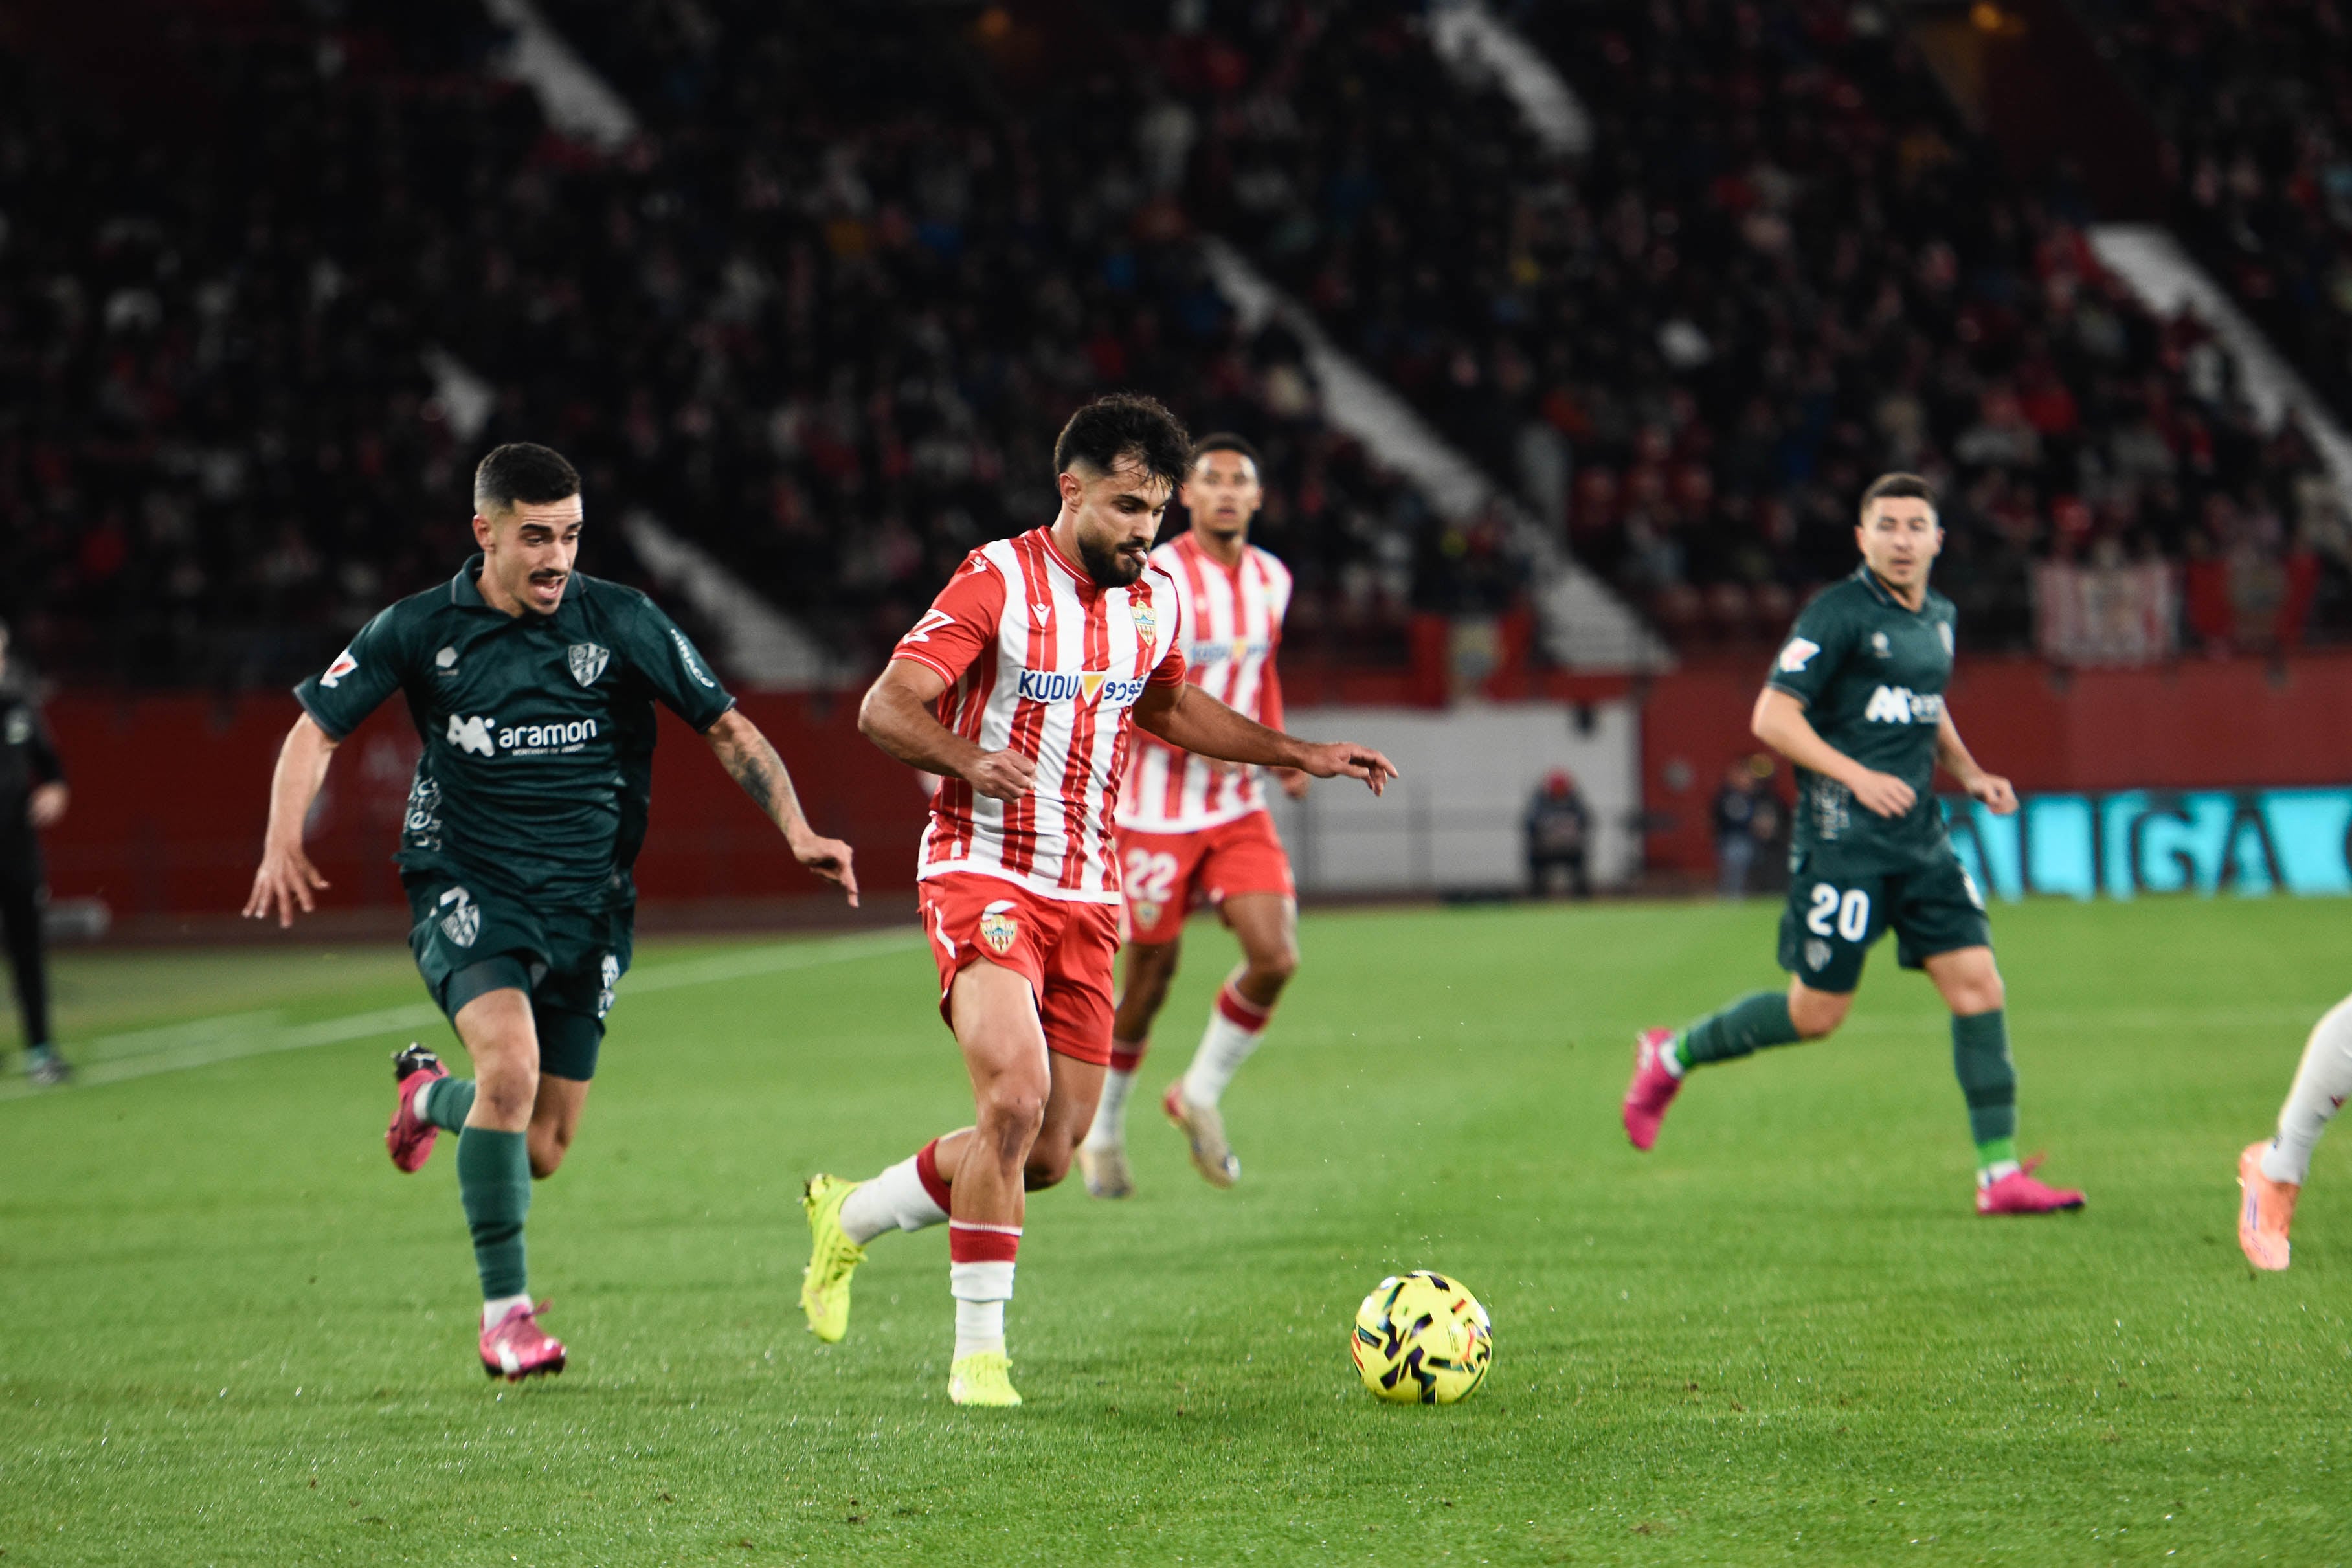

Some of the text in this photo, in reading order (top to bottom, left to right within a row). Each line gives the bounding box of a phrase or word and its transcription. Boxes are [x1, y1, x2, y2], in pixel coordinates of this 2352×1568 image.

[1018, 671, 1079, 700] KUDU
[498, 719, 598, 748] aramon
[1939, 791, 2284, 893] ALIGA
[1125, 847, 1178, 903] 22
[1807, 883, 1870, 942] 20
